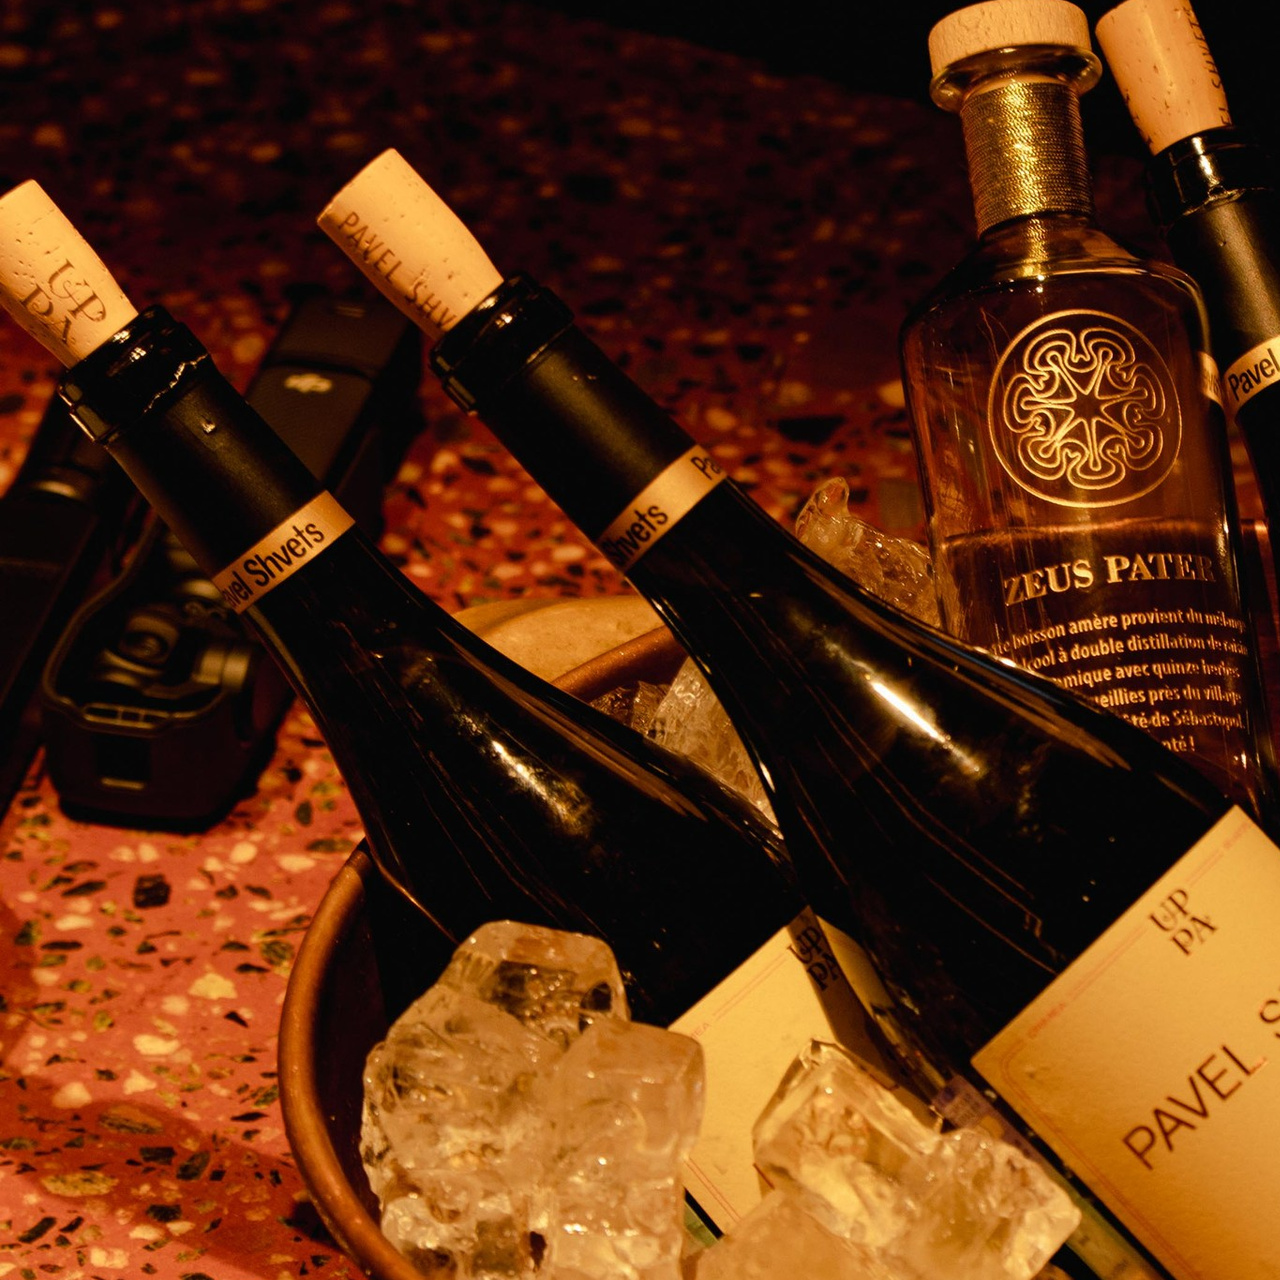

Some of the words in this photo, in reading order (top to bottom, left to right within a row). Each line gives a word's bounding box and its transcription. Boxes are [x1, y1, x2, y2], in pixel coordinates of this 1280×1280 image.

[338, 211, 403, 284] PAVEL
[243, 523, 326, 587] Shvets
[1003, 558, 1095, 607] ZEUS
[1102, 552, 1218, 584] PATER
[1012, 623, 1067, 651] boisson
[1068, 610, 1119, 635] amère
[1121, 607, 1185, 631] provient
[1186, 607, 1204, 625] du
[1057, 646, 1069, 664] à
[1070, 636, 1125, 662] double
[1126, 631, 1206, 653] distillation
[1115, 662, 1151, 680] avec
[1152, 659, 1201, 680] quinze
[1148, 682, 1181, 706] près
[1182, 683, 1202, 701] du
[1151, 709, 1171, 728] de
[1150, 888, 1189, 934] UP
[1170, 914, 1218, 957] PA
[1122, 1044, 1269, 1171] PAVEL
